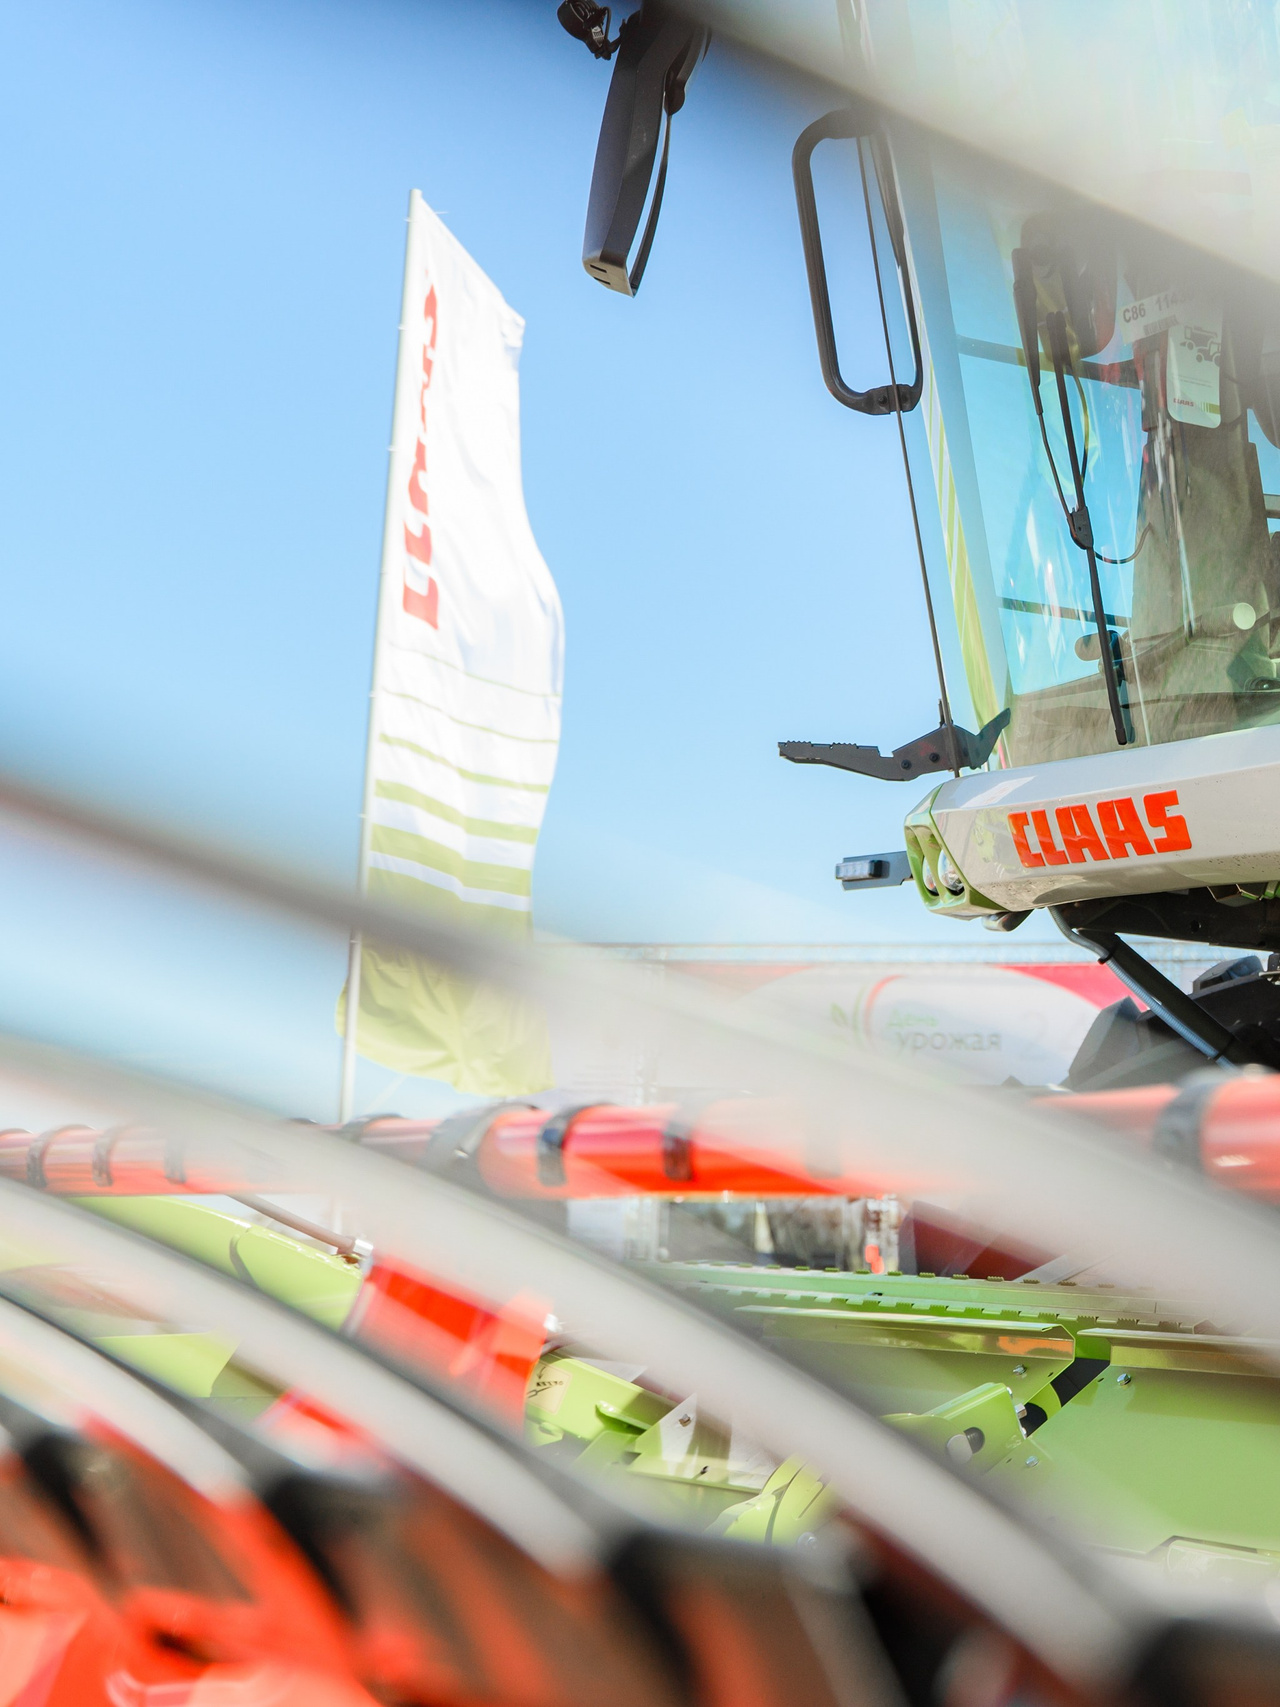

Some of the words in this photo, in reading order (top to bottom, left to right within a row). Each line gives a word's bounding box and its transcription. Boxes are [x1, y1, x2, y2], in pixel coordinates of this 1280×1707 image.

[1123, 303, 1146, 323] C86
[1007, 790, 1193, 868] CLAAS
[896, 1032, 1001, 1057] урожая
